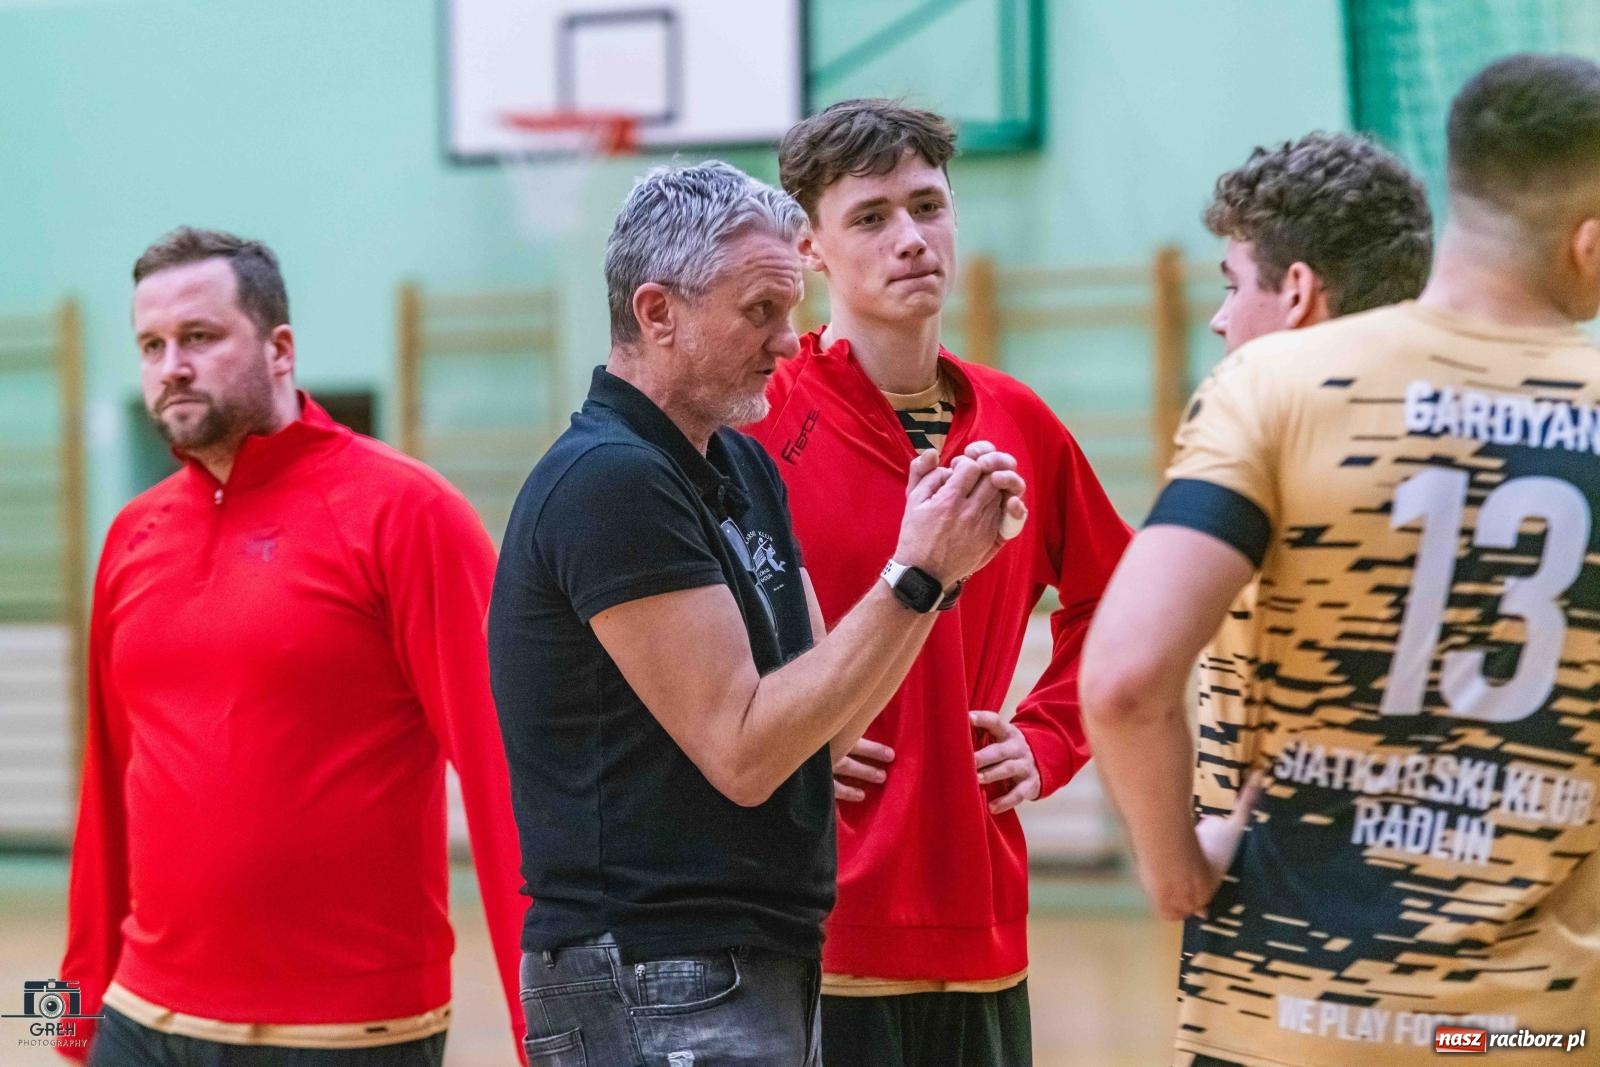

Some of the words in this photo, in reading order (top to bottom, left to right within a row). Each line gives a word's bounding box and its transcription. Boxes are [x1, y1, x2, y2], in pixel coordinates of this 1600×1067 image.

[1379, 471, 1592, 723] 13
[1273, 741, 1499, 811] SIATKARSKI
[1501, 761, 1597, 827] KLUB
[1351, 801, 1495, 866] RADLIN
[1278, 994, 1315, 1035] WE
[1318, 1002, 1391, 1044] PLAY
